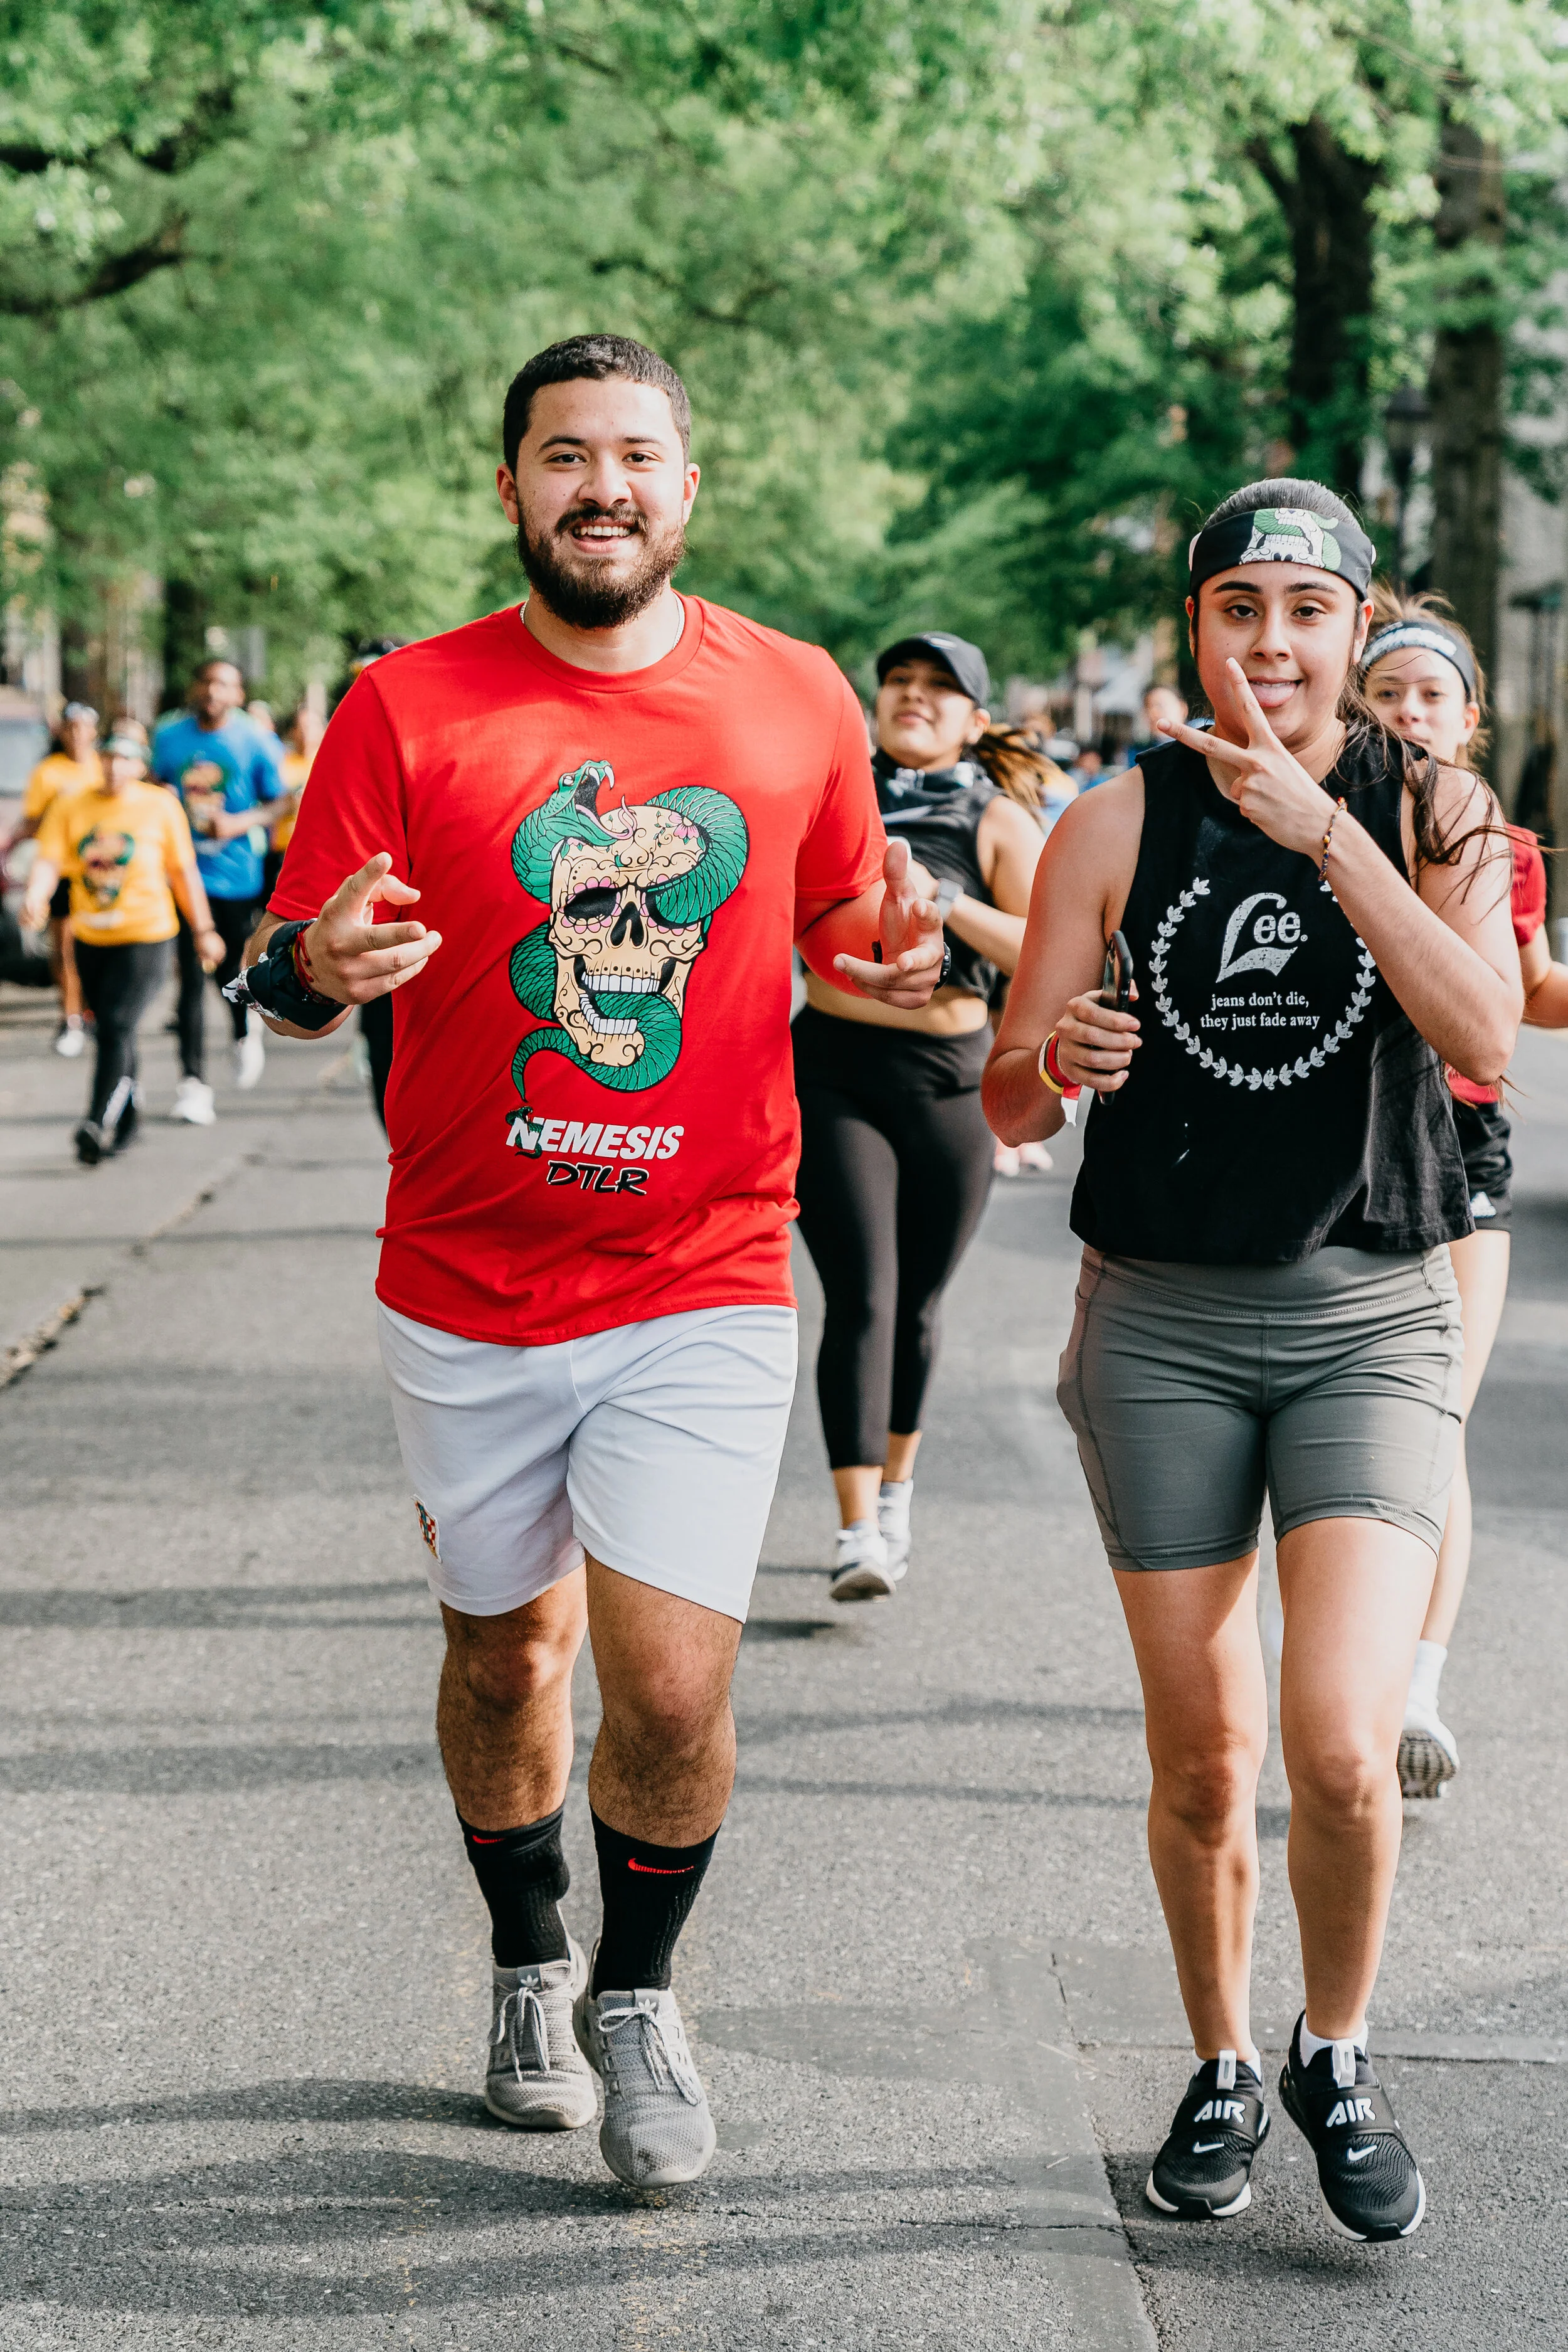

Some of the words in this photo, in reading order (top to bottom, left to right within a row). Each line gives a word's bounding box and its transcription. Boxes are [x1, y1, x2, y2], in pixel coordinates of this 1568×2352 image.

[1210, 993, 1245, 1011] jeans
[1249, 992, 1282, 1006] don't
[1286, 991, 1309, 1008] die,
[1200, 1014, 1229, 1030] they
[1231, 1014, 1256, 1030] just
[1260, 1012, 1286, 1027] fade
[1290, 1016, 1320, 1030] away
[506, 1116, 684, 1160] NEMESIS
[546, 1160, 649, 1195] DTLR
[1194, 2099, 1246, 2124] AIR
[1326, 2097, 1376, 2127] AIR
